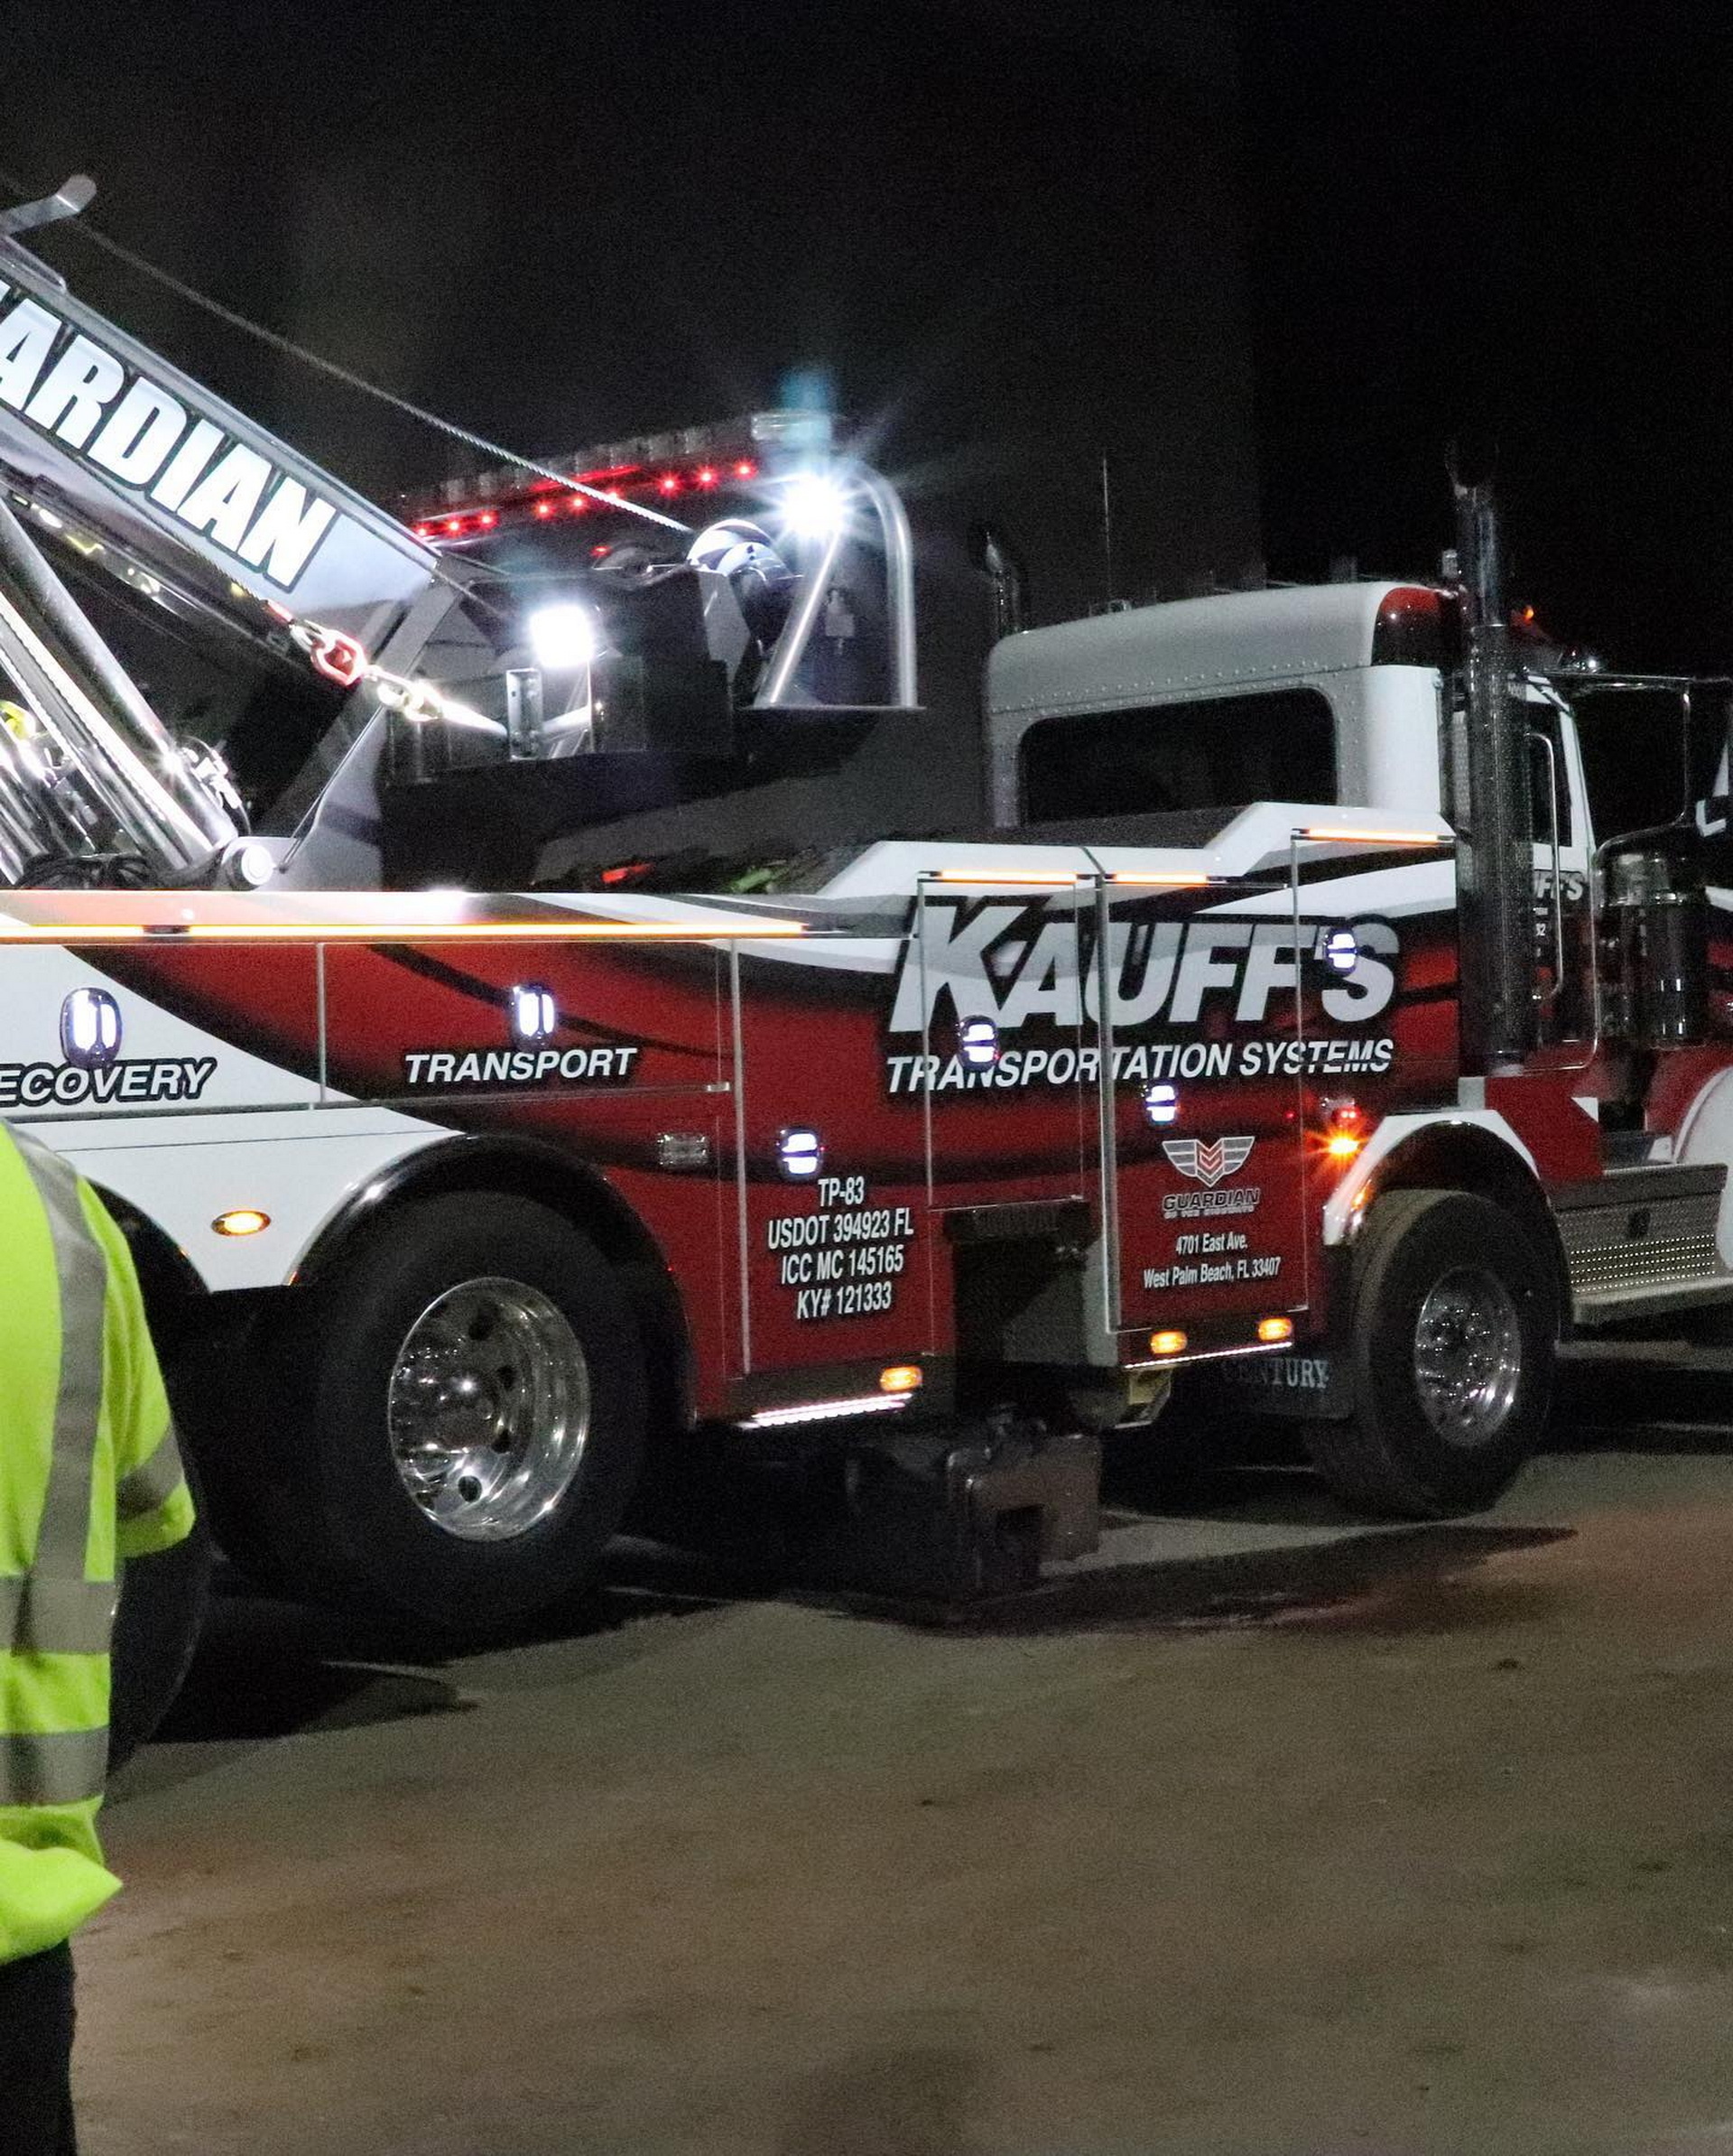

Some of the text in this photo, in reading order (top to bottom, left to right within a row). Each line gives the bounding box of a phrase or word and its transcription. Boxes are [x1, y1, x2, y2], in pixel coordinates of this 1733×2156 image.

[0, 279, 338, 588] ARDIAN
[888, 906, 1399, 1032] KAUFF'S
[405, 1047, 637, 1083] TRANSPORT
[1239, 1039, 1394, 1076] SYSTEMS
[818, 1176, 865, 1207] TP-83
[1162, 1187, 1261, 1212] GUARDIAN
[768, 1207, 914, 1250] USDOT 394923 FL
[1175, 1231, 1248, 1256] 4701 East Ave.
[781, 1244, 904, 1285] ICC MC 145165
[1144, 1268, 1170, 1289] West
[1172, 1266, 1198, 1286] Palm
[1237, 1259, 1251, 1278] FL
[1252, 1256, 1282, 1278] 33407
[797, 1281, 892, 1320] KY# 121333
